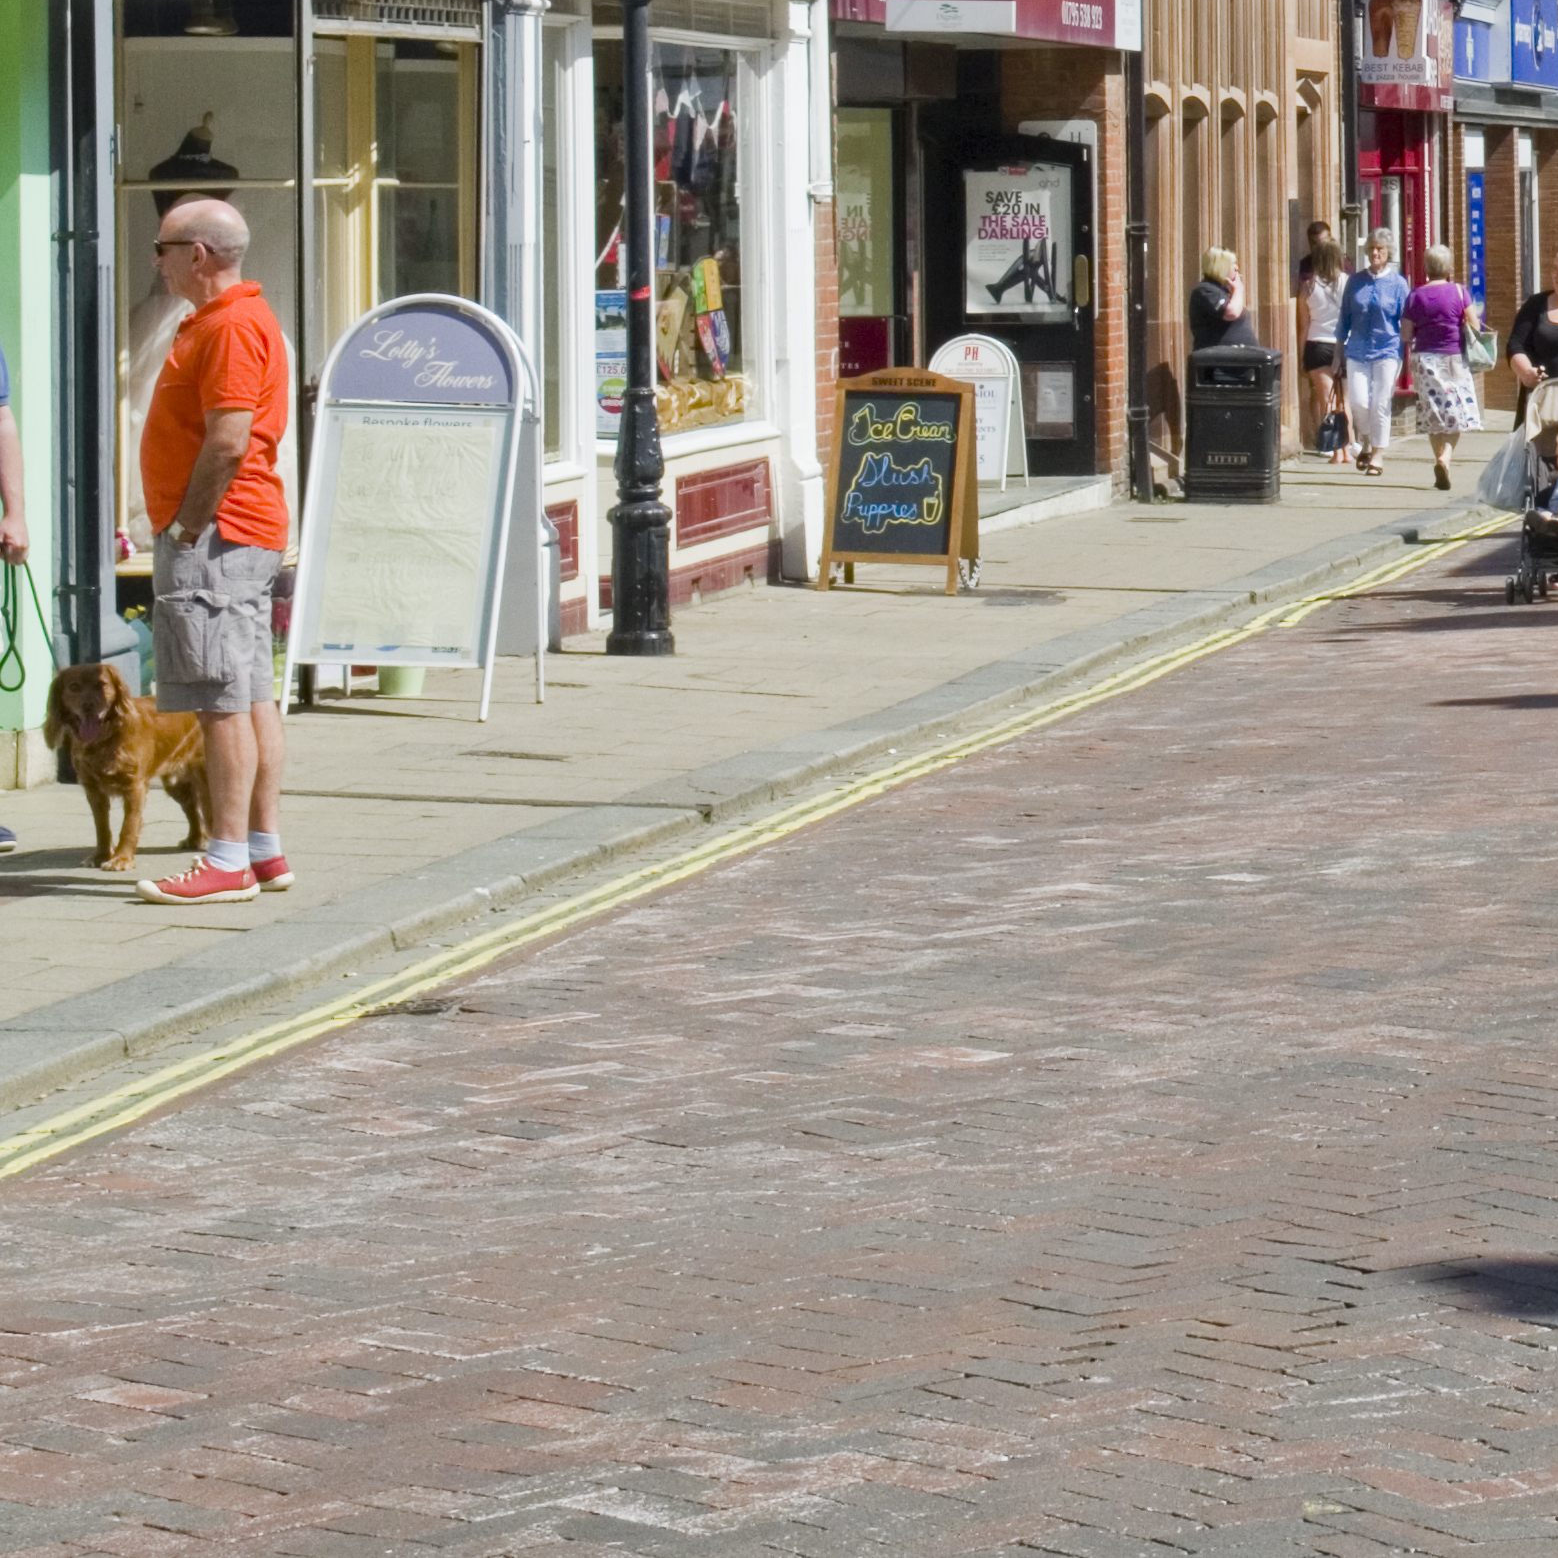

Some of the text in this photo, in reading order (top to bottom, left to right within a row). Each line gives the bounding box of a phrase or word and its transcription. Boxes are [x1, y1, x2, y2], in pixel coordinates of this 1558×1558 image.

[1364, 63, 1424, 73] BEST KEBAB
[985, 190, 1023, 203] SAVE
[991, 203, 1041, 215] £20 IN
[980, 215, 1046, 228] THE SALE
[977, 227, 1049, 240] DARLING!
[359, 329, 439, 369] Lotty's
[413, 360, 498, 390] Flowers
[871, 377, 937, 387] SWEET SCENE
[851, 407, 893, 441] Ice
[858, 454, 935, 487] Slush
[845, 492, 918, 527] Puppies
